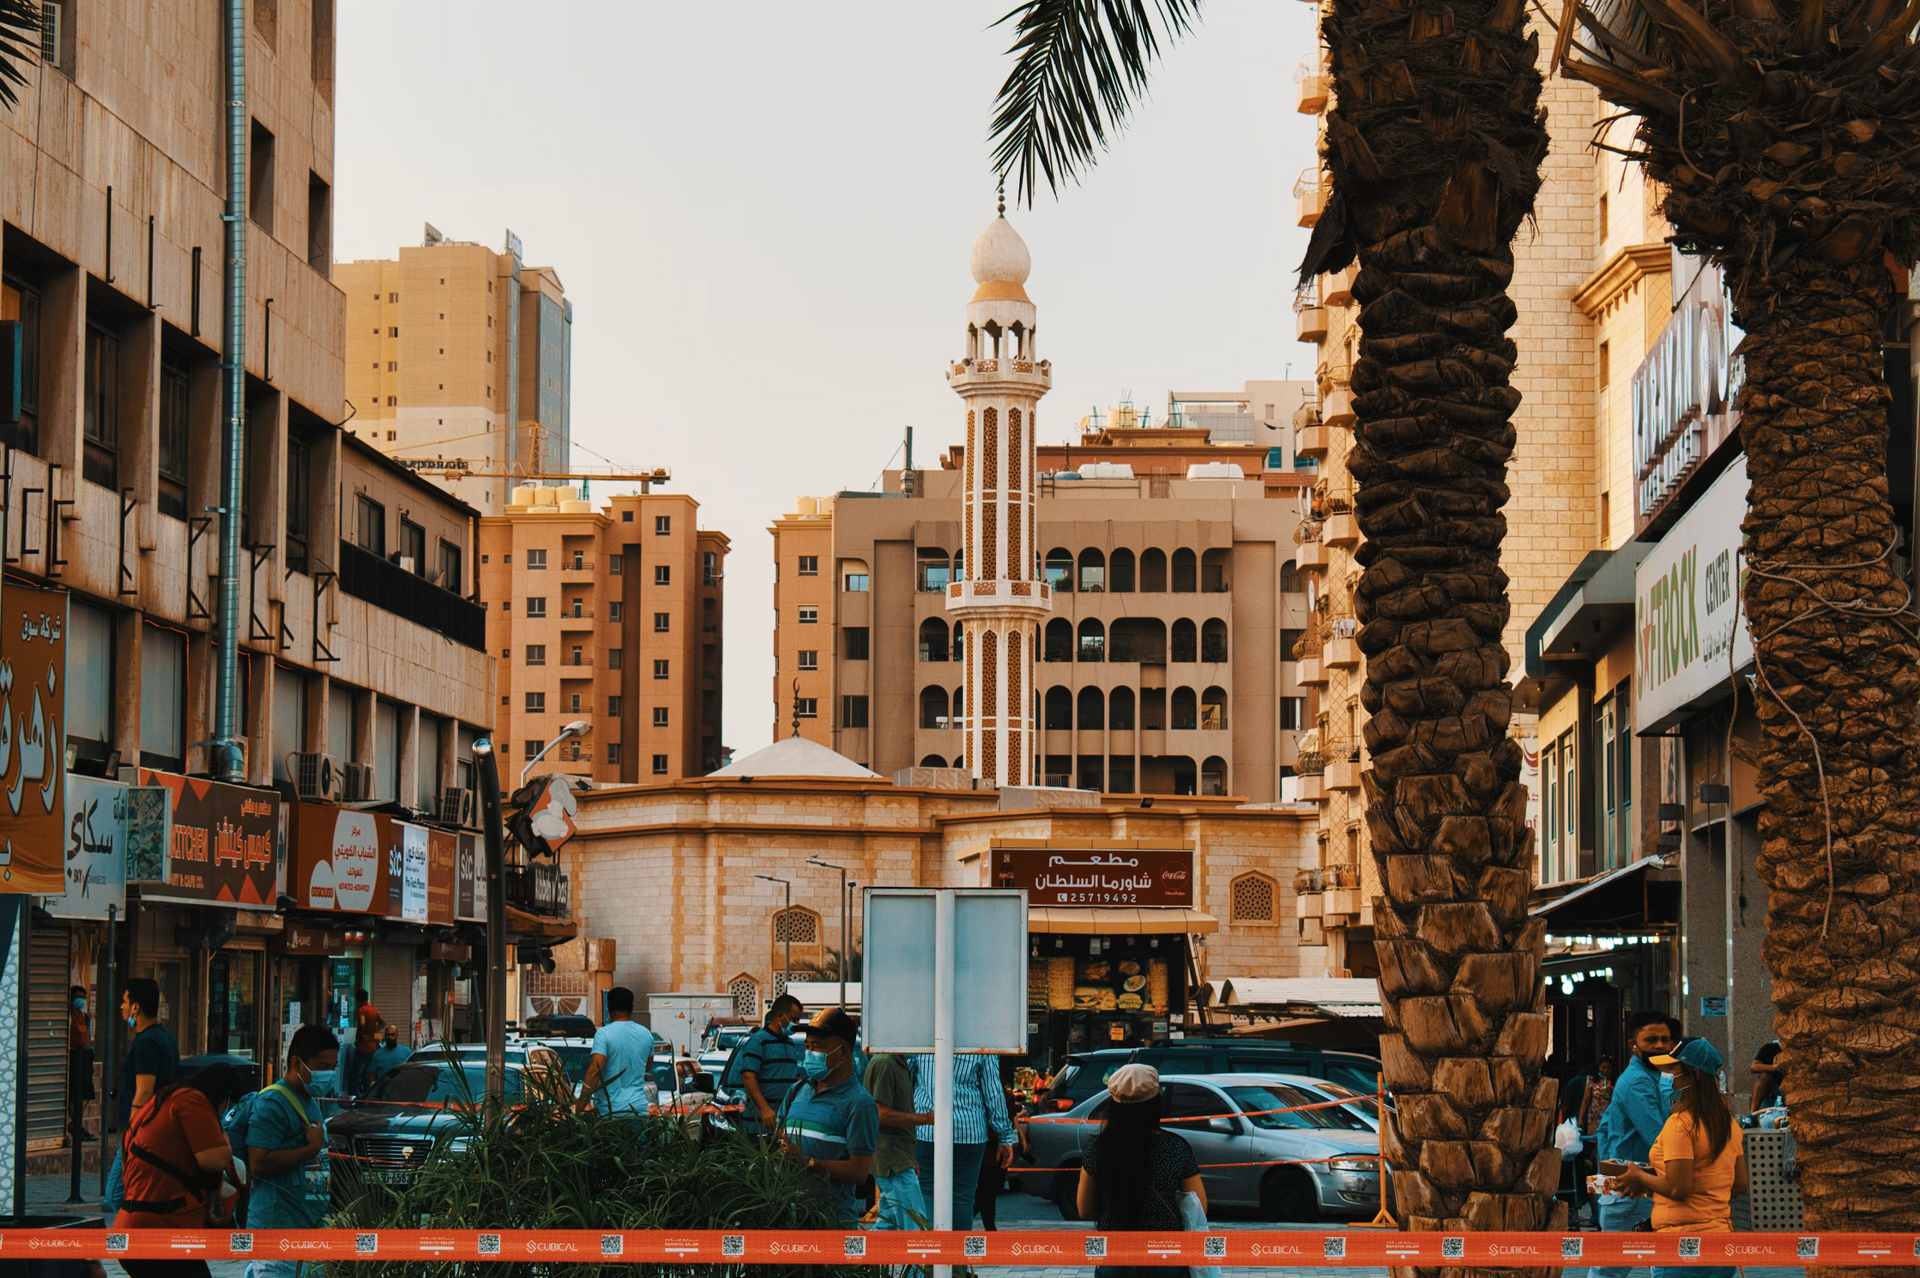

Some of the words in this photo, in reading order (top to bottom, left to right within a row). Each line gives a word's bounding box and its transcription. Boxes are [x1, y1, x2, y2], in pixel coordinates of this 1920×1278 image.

[1633, 302, 1695, 481] KABAYAN
[1705, 548, 1731, 617] CENTER
[21, 611, 39, 641] سوق
[40, 613, 61, 645] شركة
[244, 829, 271, 871] كيمس
[357, 845, 376, 862] الشباب
[389, 844, 402, 877] stc
[460, 848, 474, 881] stc
[1049, 853, 1139, 868] مطعم
[73, 868, 83, 883] SKY
[1035, 873, 1099, 891] السلطان
[1102, 872, 1152, 891] شاورما
[1071, 893, 1137, 903] 25719492
[40, 1240, 82, 1248] CUBICAL
[290, 1241, 333, 1250] CUBICAL
[537, 1242, 579, 1251] CUBICAL
[780, 1244, 822, 1252] CUBICAL
[1022, 1245, 1063, 1253] CUBICAL
[1261, 1245, 1302, 1254] CUBICAL
[1499, 1246, 1540, 1254] CUBICAL
[1735, 1246, 1775, 1254] CUBICAL
